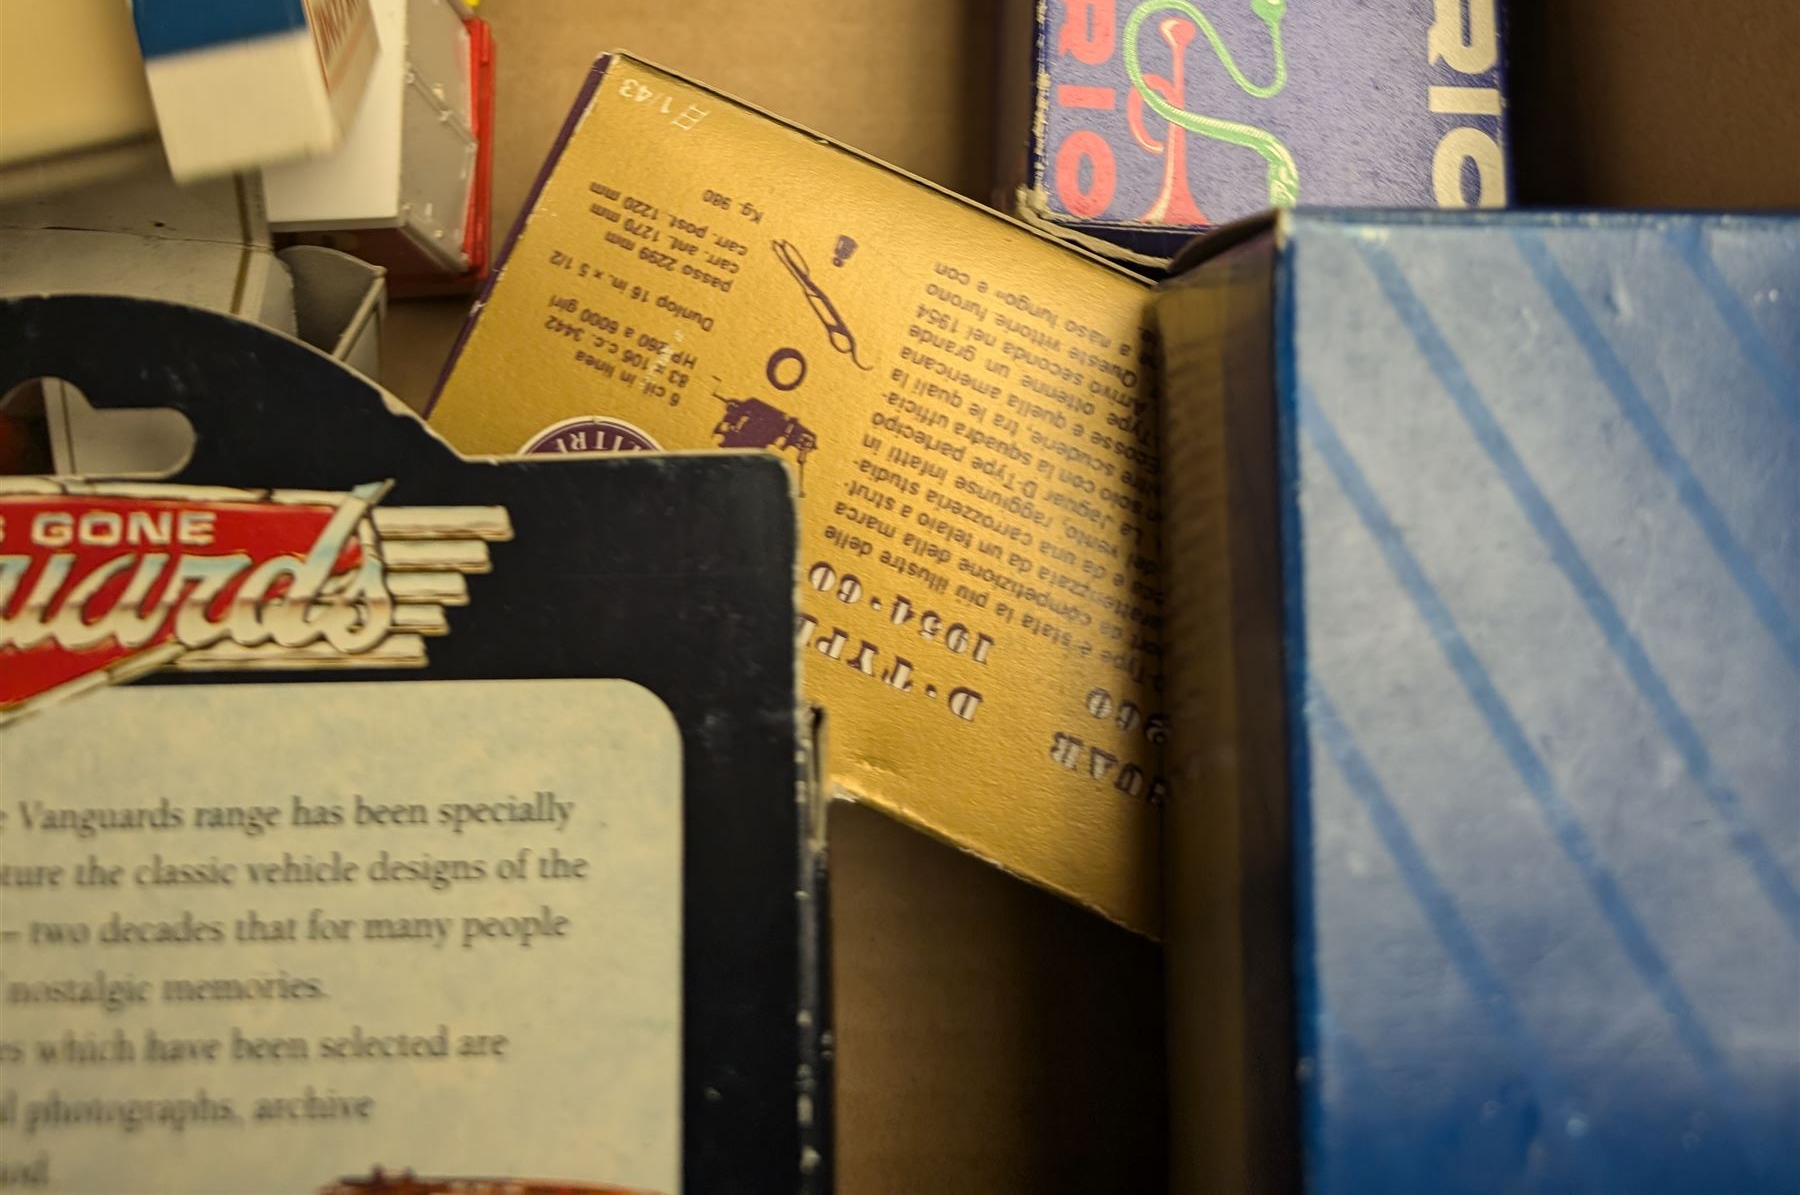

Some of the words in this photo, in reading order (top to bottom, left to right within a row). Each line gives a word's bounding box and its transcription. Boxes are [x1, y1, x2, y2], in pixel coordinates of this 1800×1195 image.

[589, 182, 619, 201] mm
[703, 189, 731, 210] 980
[590, 204, 620, 222] mm
[623, 196, 658, 220] 1220
[605, 232, 634, 251] mm
[668, 235, 698, 255] ant.
[713, 233, 747, 256] carr.
[549, 250, 572, 269] 1/2
[578, 262, 589, 277] 5
[639, 246, 677, 271] 2299
[705, 251, 739, 274] carr.
[681, 264, 732, 292] passo
[934, 263, 969, 285] con
[976, 280, 988, 293] e
[630, 285, 648, 302] 16
[925, 283, 987, 321] furono
[580, 308, 617, 334] 6000
[655, 295, 713, 331] Dunlop
[916, 305, 958, 333] 1954
[544, 315, 584, 341] 3442
[624, 326, 634, 338] a
[966, 327, 996, 346] nel
[1064, 319, 1110, 348] naso
[638, 334, 668, 355] 260
[908, 324, 975, 361] grande
[574, 350, 614, 377] linea
[621, 349, 648, 370] 106
[670, 351, 696, 369] HP
[900, 346, 1000, 398] americana
[985, 359, 1010, 378] un
[1002, 341, 1083, 385] seconda
[1070, 349, 1140, 388] Queste
[619, 371, 636, 384] in
[667, 369, 688, 388] 83
[890, 367, 909, 388] la
[669, 392, 679, 406] 6
[912, 377, 962, 408] quali
[1021, 375, 1095, 415] ottenne
[882, 391, 948, 427] ufficia-
[968, 402, 986, 422] le
[1006, 393, 1066, 428] quella
[992, 413, 1019, 436] tra
[862, 433, 882, 455] in
[953, 421, 1031, 465] squadra
[853, 459, 919, 495] studia-
[887, 446, 946, 484] infatti
[971, 455, 1037, 498] D-Type
[1058, 471, 1095, 493] con
[899, 504, 912, 517] a
[954, 474, 1051, 527] raggiunse
[1043, 489, 1114, 529] Jaguar
[31, 511, 218, 548] GONE
[834, 501, 895, 537] marca
[917, 512, 972, 548] telaio
[925, 489, 1031, 545] carrozzeria
[824, 525, 872, 556] delle
[902, 532, 950, 564] della
[977, 541, 1002, 559] un
[1039, 540, 1076, 564] una
[879, 550, 948, 593] illustre
[1007, 552, 1032, 572] da
[1082, 559, 1107, 579] da
[958, 557, 1091, 625] competizione
[995, 602, 1014, 623] la
[1021, 613, 1070, 646] stata
[19, 797, 184, 838] Vanguards
[194, 806, 282, 837] range
[291, 794, 345, 827] has
[353, 794, 429, 826] been
[437, 790, 576, 833] specially
[75, 854, 125, 887] the
[135, 854, 236, 887] classic
[246, 851, 360, 885] vehicle
[367, 850, 486, 890] designs
[496, 847, 531, 880] of
[537, 846, 590, 881] the
[29, 920, 91, 945] two
[100, 910, 225, 944] decades
[234, 908, 299, 942] that
[306, 907, 352, 941] for
[362, 916, 451, 951] many
[461, 904, 572, 948] people
[8, 969, 152, 1012] nostalgic
[162, 974, 332, 1003] memories.
[35, 1028, 136, 1065] which
[144, 1027, 221, 1063] have
[231, 1026, 309, 1061] been
[319, 1024, 450, 1060] selected
[457, 1031, 510, 1059] are
[253, 1086, 375, 1123] archive
